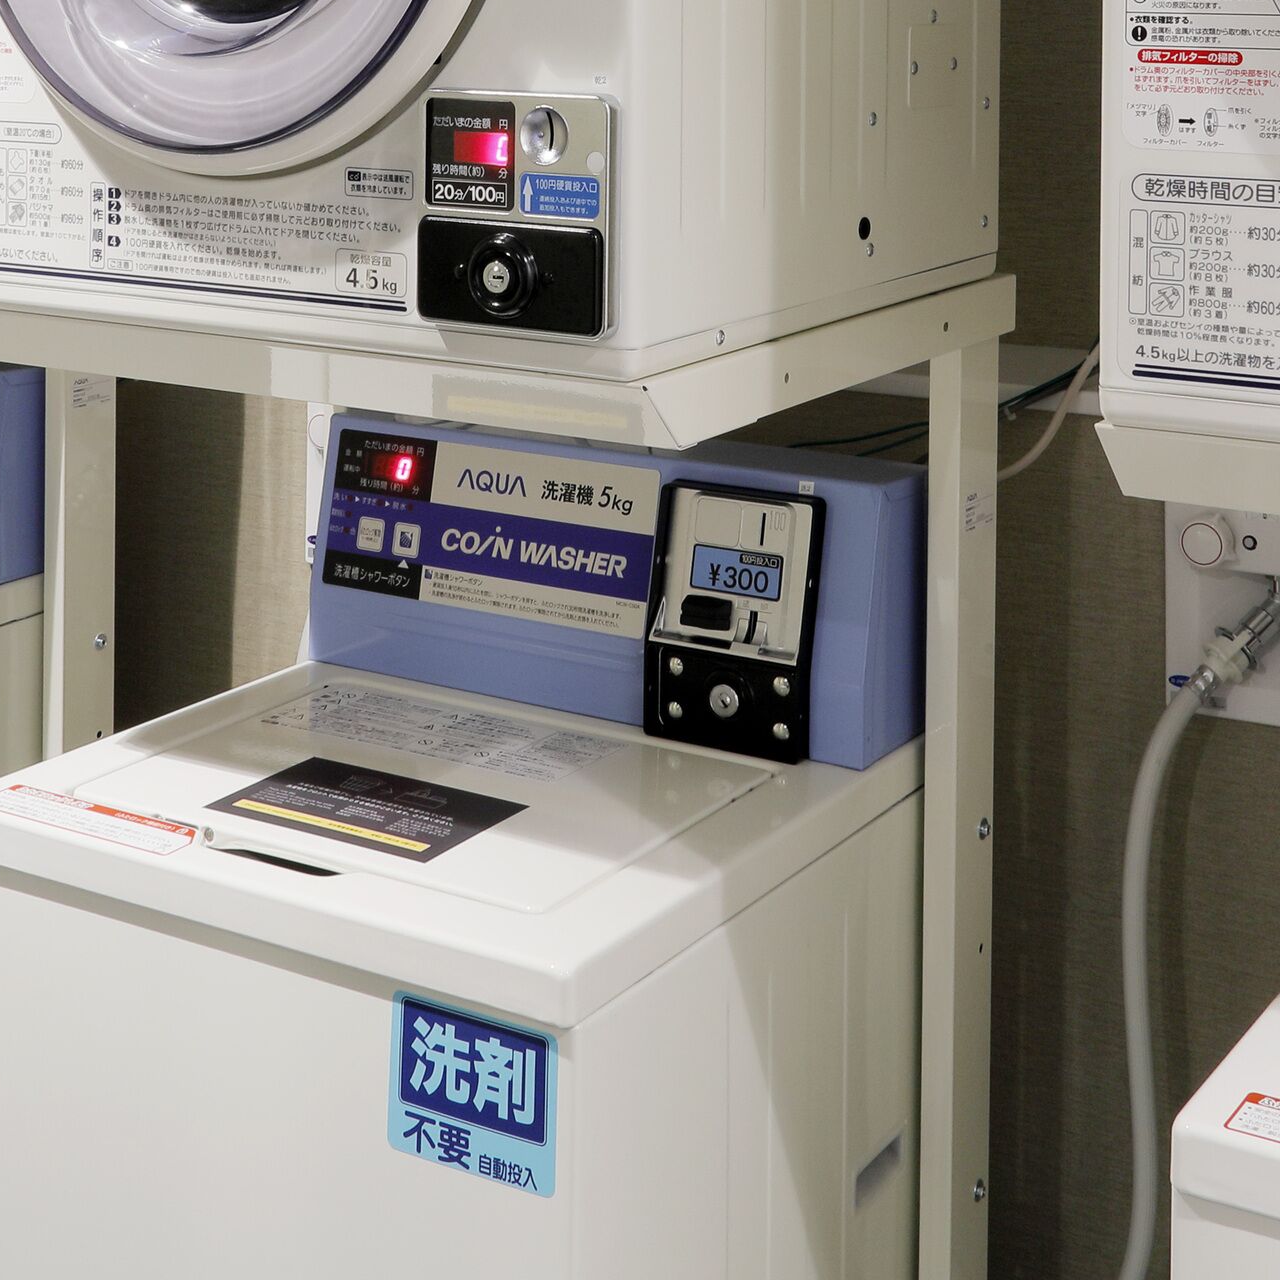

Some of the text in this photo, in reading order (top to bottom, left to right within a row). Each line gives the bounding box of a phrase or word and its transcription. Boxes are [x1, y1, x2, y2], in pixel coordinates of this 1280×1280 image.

[1151, 1, 1222, 10] 火災の原因になります。
[1135, 15, 1194, 25] 衣類を確認する。
[1151, 35, 1221, 44] 感電の恐れがあります。
[1142, 50, 1239, 64] 排気フィルターの掃除
[433, 117, 508, 130] ただいまの金額 円
[498, 168, 508, 179] 分
[435, 184, 504, 203] 20分/100円
[1189, 249, 1233, 261] ブラウス
[364, 440, 413, 455] ただいまの金額
[396, 457, 413, 480] 0
[457, 468, 526, 497] AQUA
[540, 479, 633, 515] 洗濯機 5kg
[520, 540, 628, 579] WASHER
[334, 563, 411, 587] 洗濯槽シャワーボタン
[709, 563, 768, 593] ¥300
[409, 1016, 536, 1125] 洗剤
[403, 1111, 538, 1191] 不要 自動投入
